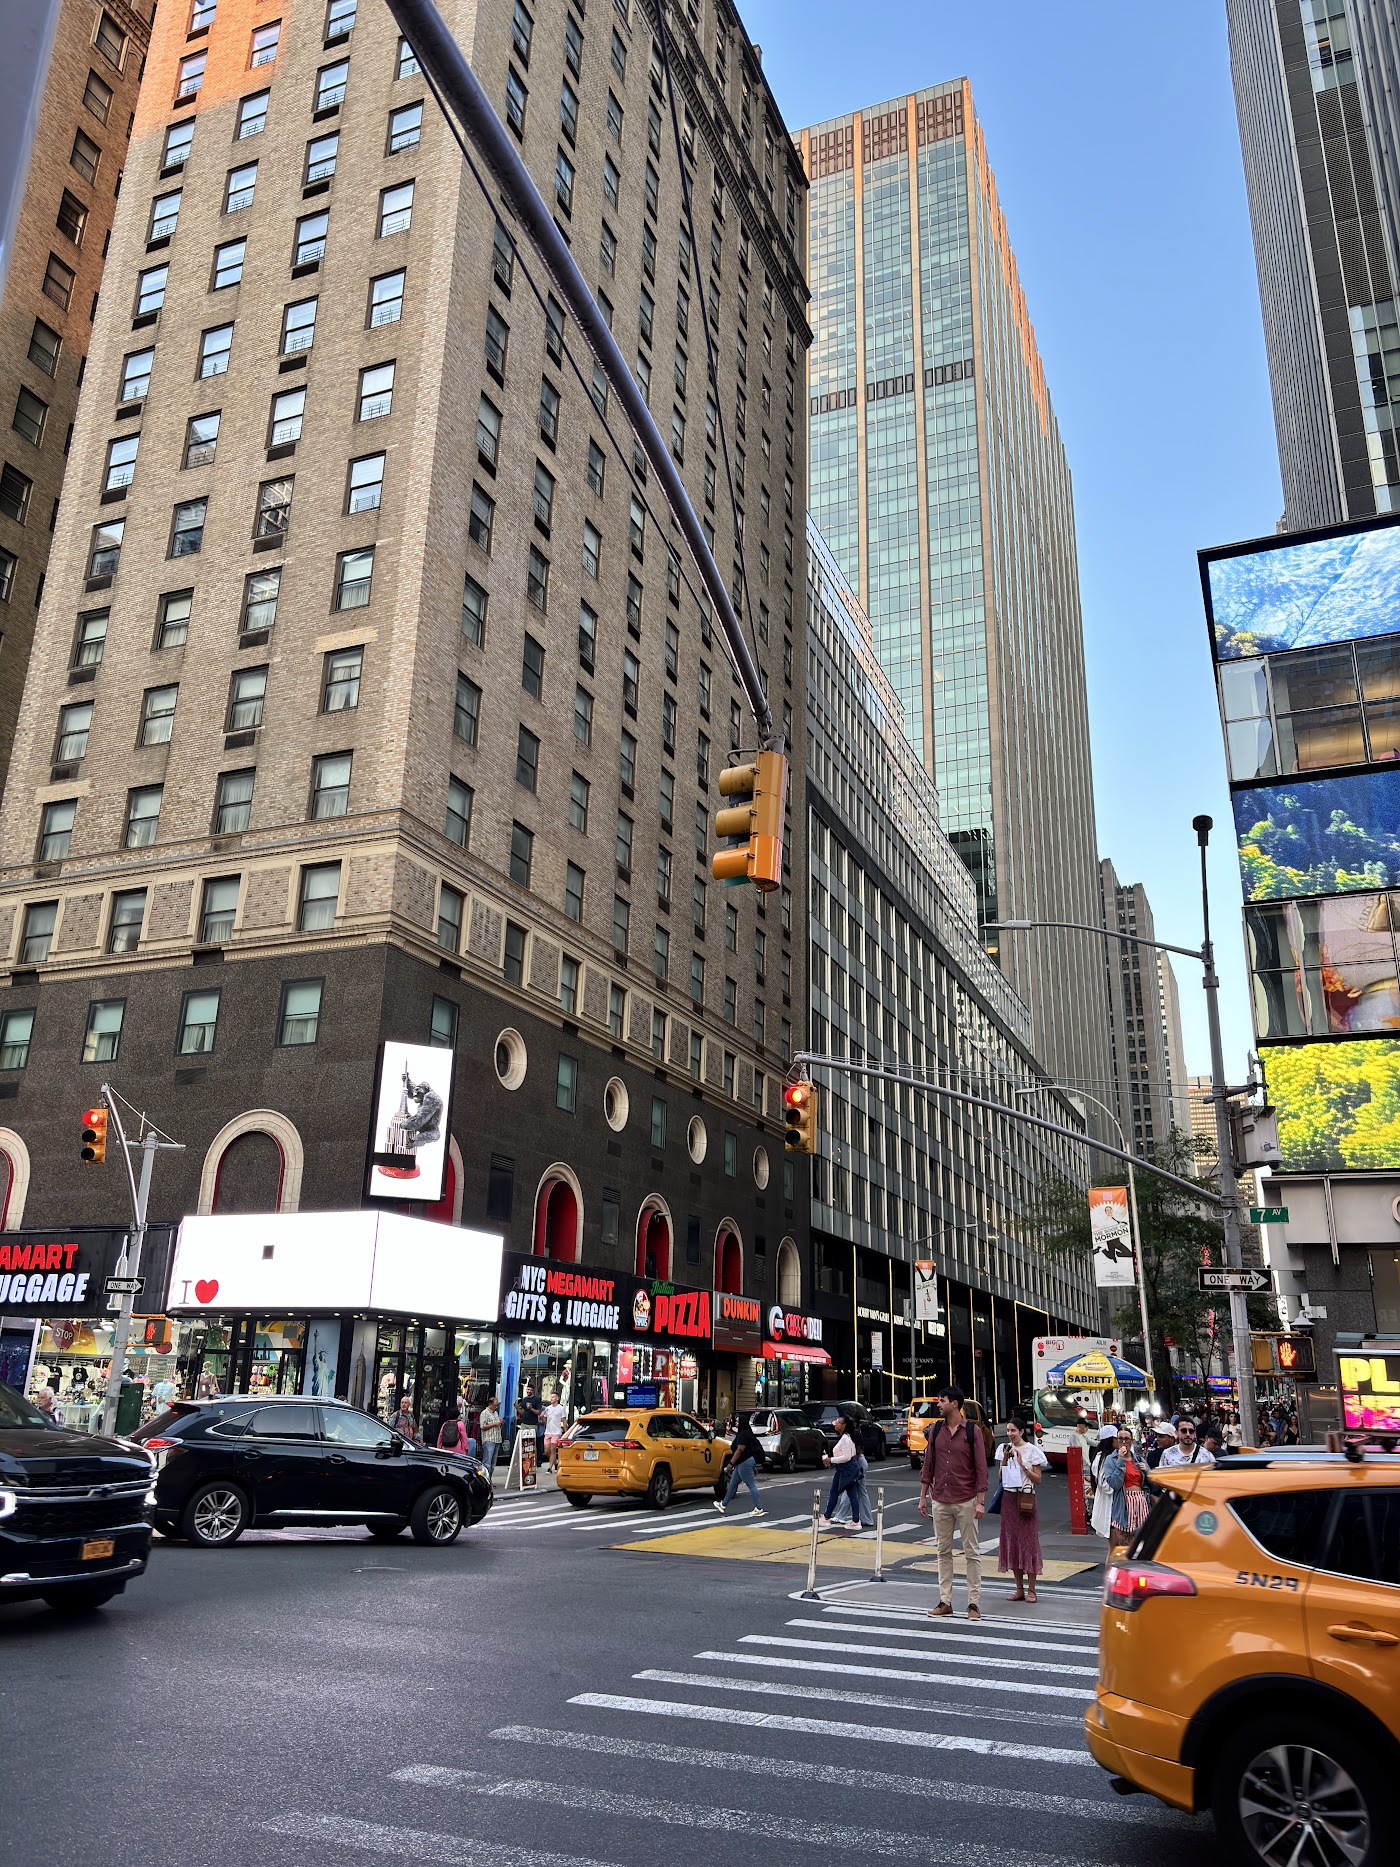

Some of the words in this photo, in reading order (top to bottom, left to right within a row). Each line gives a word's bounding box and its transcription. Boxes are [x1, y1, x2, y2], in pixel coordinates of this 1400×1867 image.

[1256, 1209, 1266, 1221] 7
[1271, 1208, 1282, 1216] AV
[1094, 1227, 1129, 1243] MORMON
[110, 1281, 121, 1289] ONE
[126, 1281, 139, 1290] WAY
[520, 1264, 547, 1293] NYC
[546, 1269, 614, 1302] MEGAMART
[1209, 1275, 1231, 1285] ONE
[1239, 1275, 1261, 1286] WAY
[505, 1290, 548, 1323] GIFTS
[551, 1301, 561, 1325] &
[565, 1299, 620, 1331] LUGGAGE
[654, 1291, 711, 1339] PIZZA
[55, 1326, 73, 1340] STOP
[1067, 1374, 1112, 1384] SABRETT
[1234, 1570, 1299, 1592] 5N29
